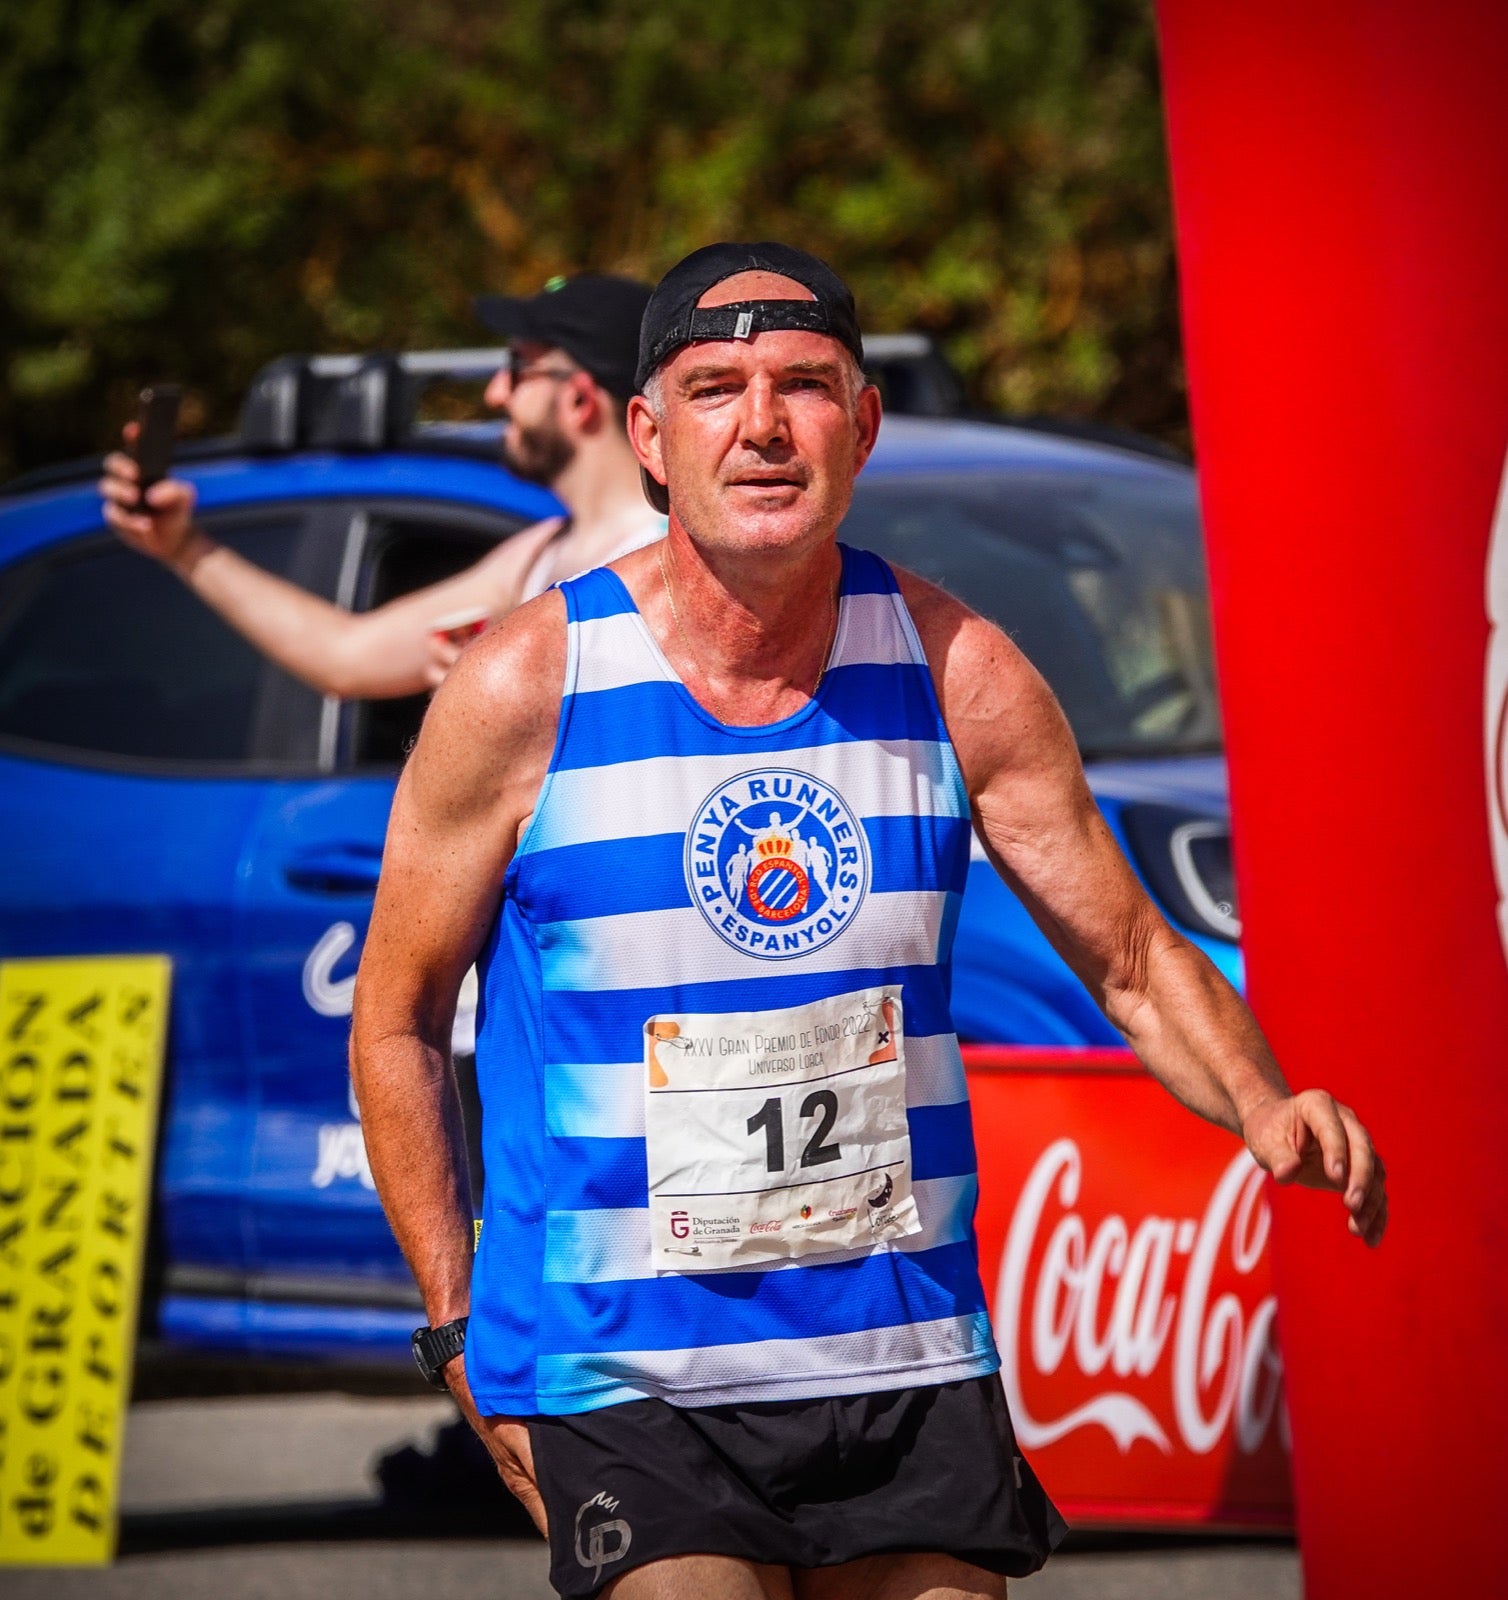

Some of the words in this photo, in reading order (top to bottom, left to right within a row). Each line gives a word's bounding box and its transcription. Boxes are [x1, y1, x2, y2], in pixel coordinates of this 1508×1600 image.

[696, 795, 740, 903] PENYA
[747, 778, 858, 890] RUNNERS
[721, 908, 847, 951] ESPANYOL
[843, 1014, 872, 1038] 2022
[748, 1056, 796, 1076] UNIVERSO
[799, 1051, 824, 1070] LORCA
[747, 1089, 842, 1173] 12
[17, 993, 104, 1427] GRANADA
[692, 1216, 740, 1227] Diputación
[692, 1227, 702, 1235] de
[704, 1225, 740, 1235] Granada
[70, 985, 150, 1532] DEPORTES
